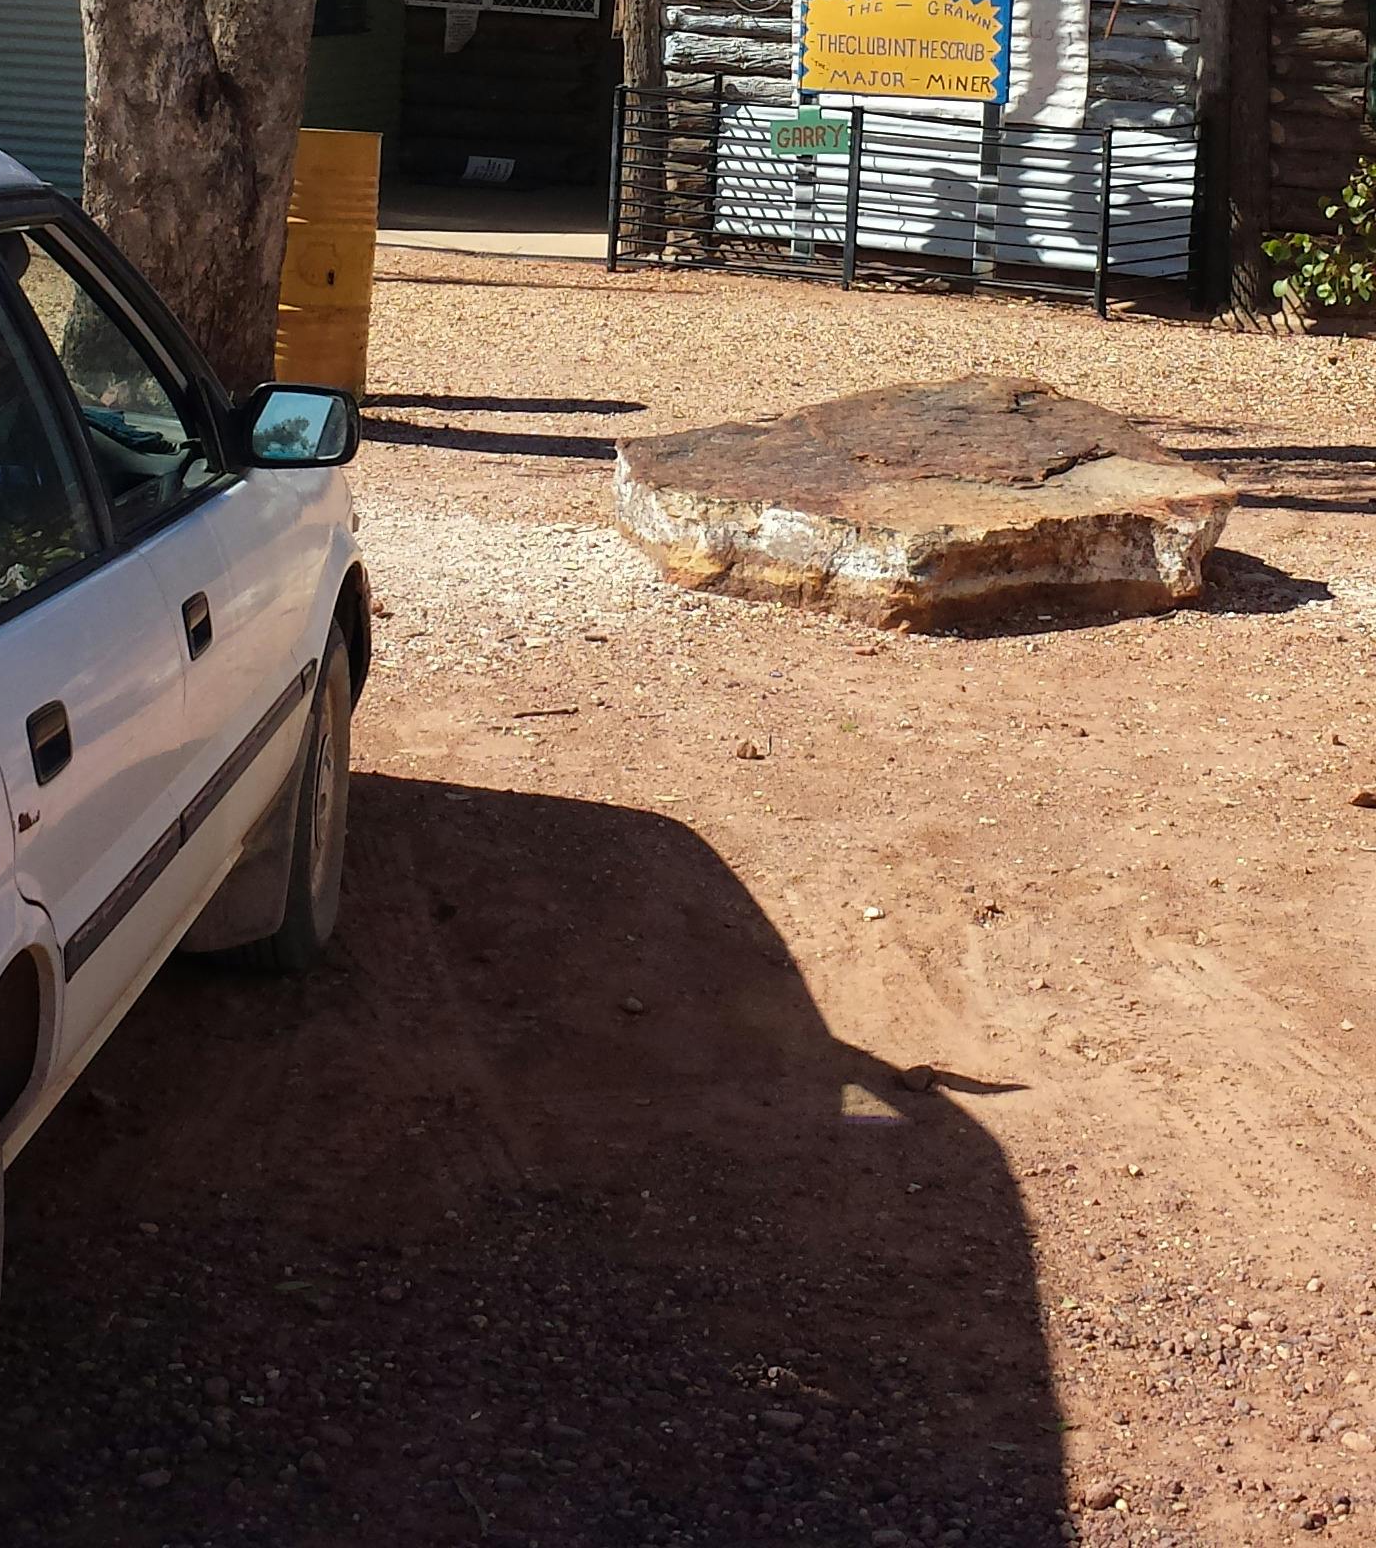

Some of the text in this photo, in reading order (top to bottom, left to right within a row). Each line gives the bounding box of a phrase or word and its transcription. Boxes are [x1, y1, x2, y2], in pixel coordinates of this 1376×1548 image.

[847, 2, 884, 17] THE
[829, 69, 905, 88] MAJOR
[776, 123, 845, 149] GARRY
